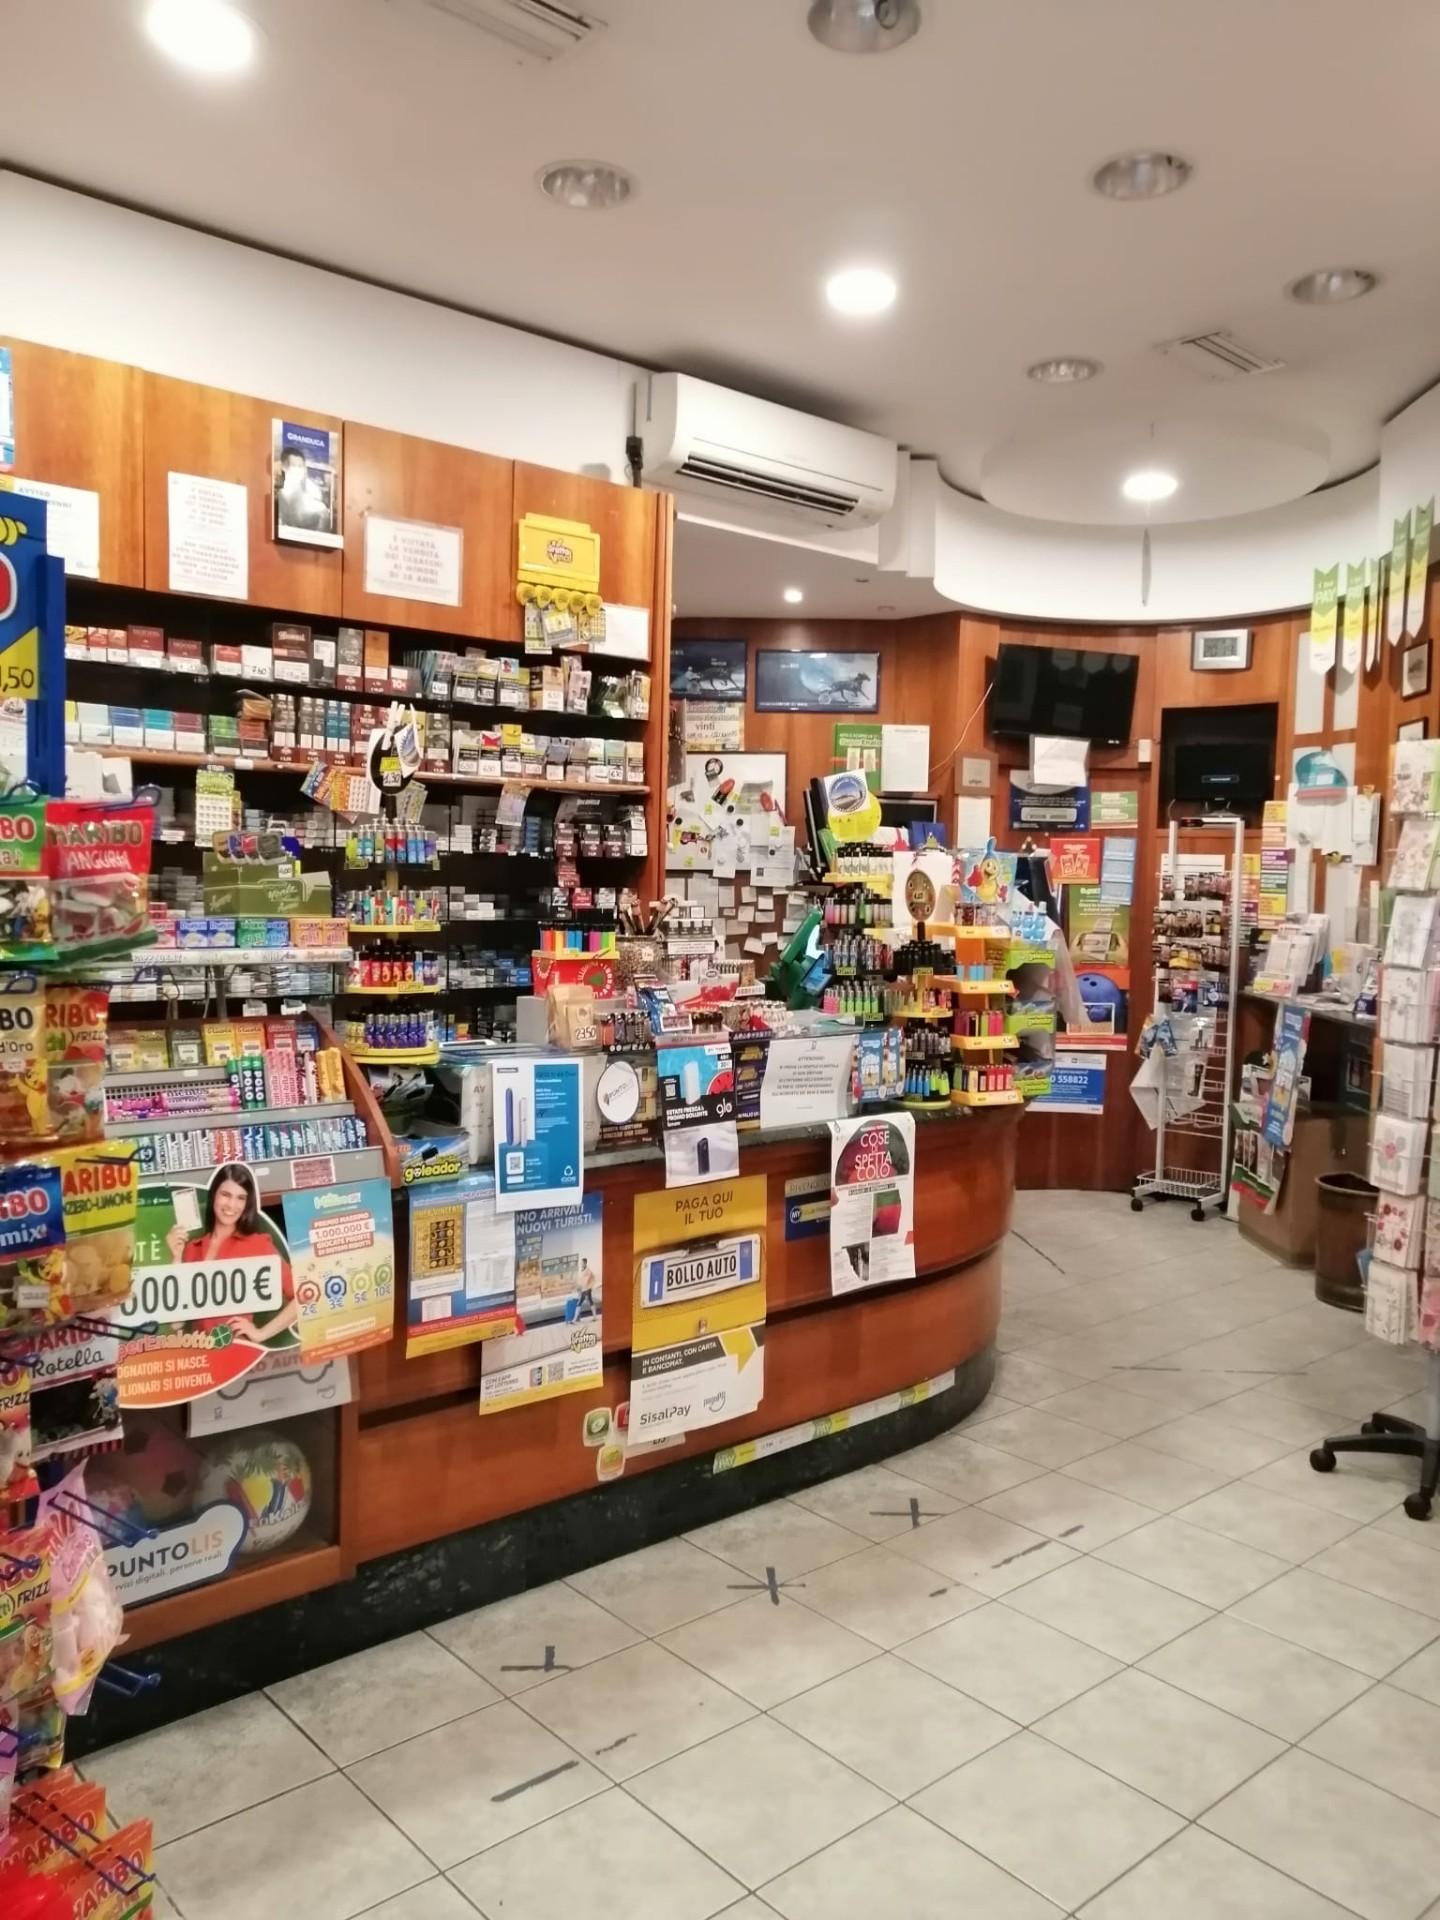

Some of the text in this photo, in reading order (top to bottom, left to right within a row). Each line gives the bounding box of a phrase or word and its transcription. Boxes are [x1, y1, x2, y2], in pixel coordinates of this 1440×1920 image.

[244, 1069, 254, 1101] POLO
[254, 1069, 264, 1101] POLO
[716, 1097, 733, 1118] glo
[860, 1130, 890, 1148] COSE
[855, 1150, 893, 1170] SPETTA
[857, 1163, 891, 1182] COLO
[675, 1191, 733, 1213] PAGA QUI
[540, 1203, 584, 1221] ARRIVATI
[684, 1207, 724, 1225] IL TUO
[315, 1222, 362, 1241] 1.000.000
[517, 1222, 551, 1236] NUOVI
[151, 1232, 161, 1261] È
[666, 1255, 737, 1287] BOLLO AUTO
[302, 1304, 318, 1317] 2€
[328, 1297, 344, 1310] 3€
[32, 1347, 104, 1378] Rotella
[642, 1358, 649, 1367] IN
[684, 1347, 697, 1357] CON
[698, 1342, 717, 1353] CARTA
[165, 1359, 175, 1372] SI
[163, 1377, 173, 1391] SI
[639, 1403, 691, 1426] SisalPay
